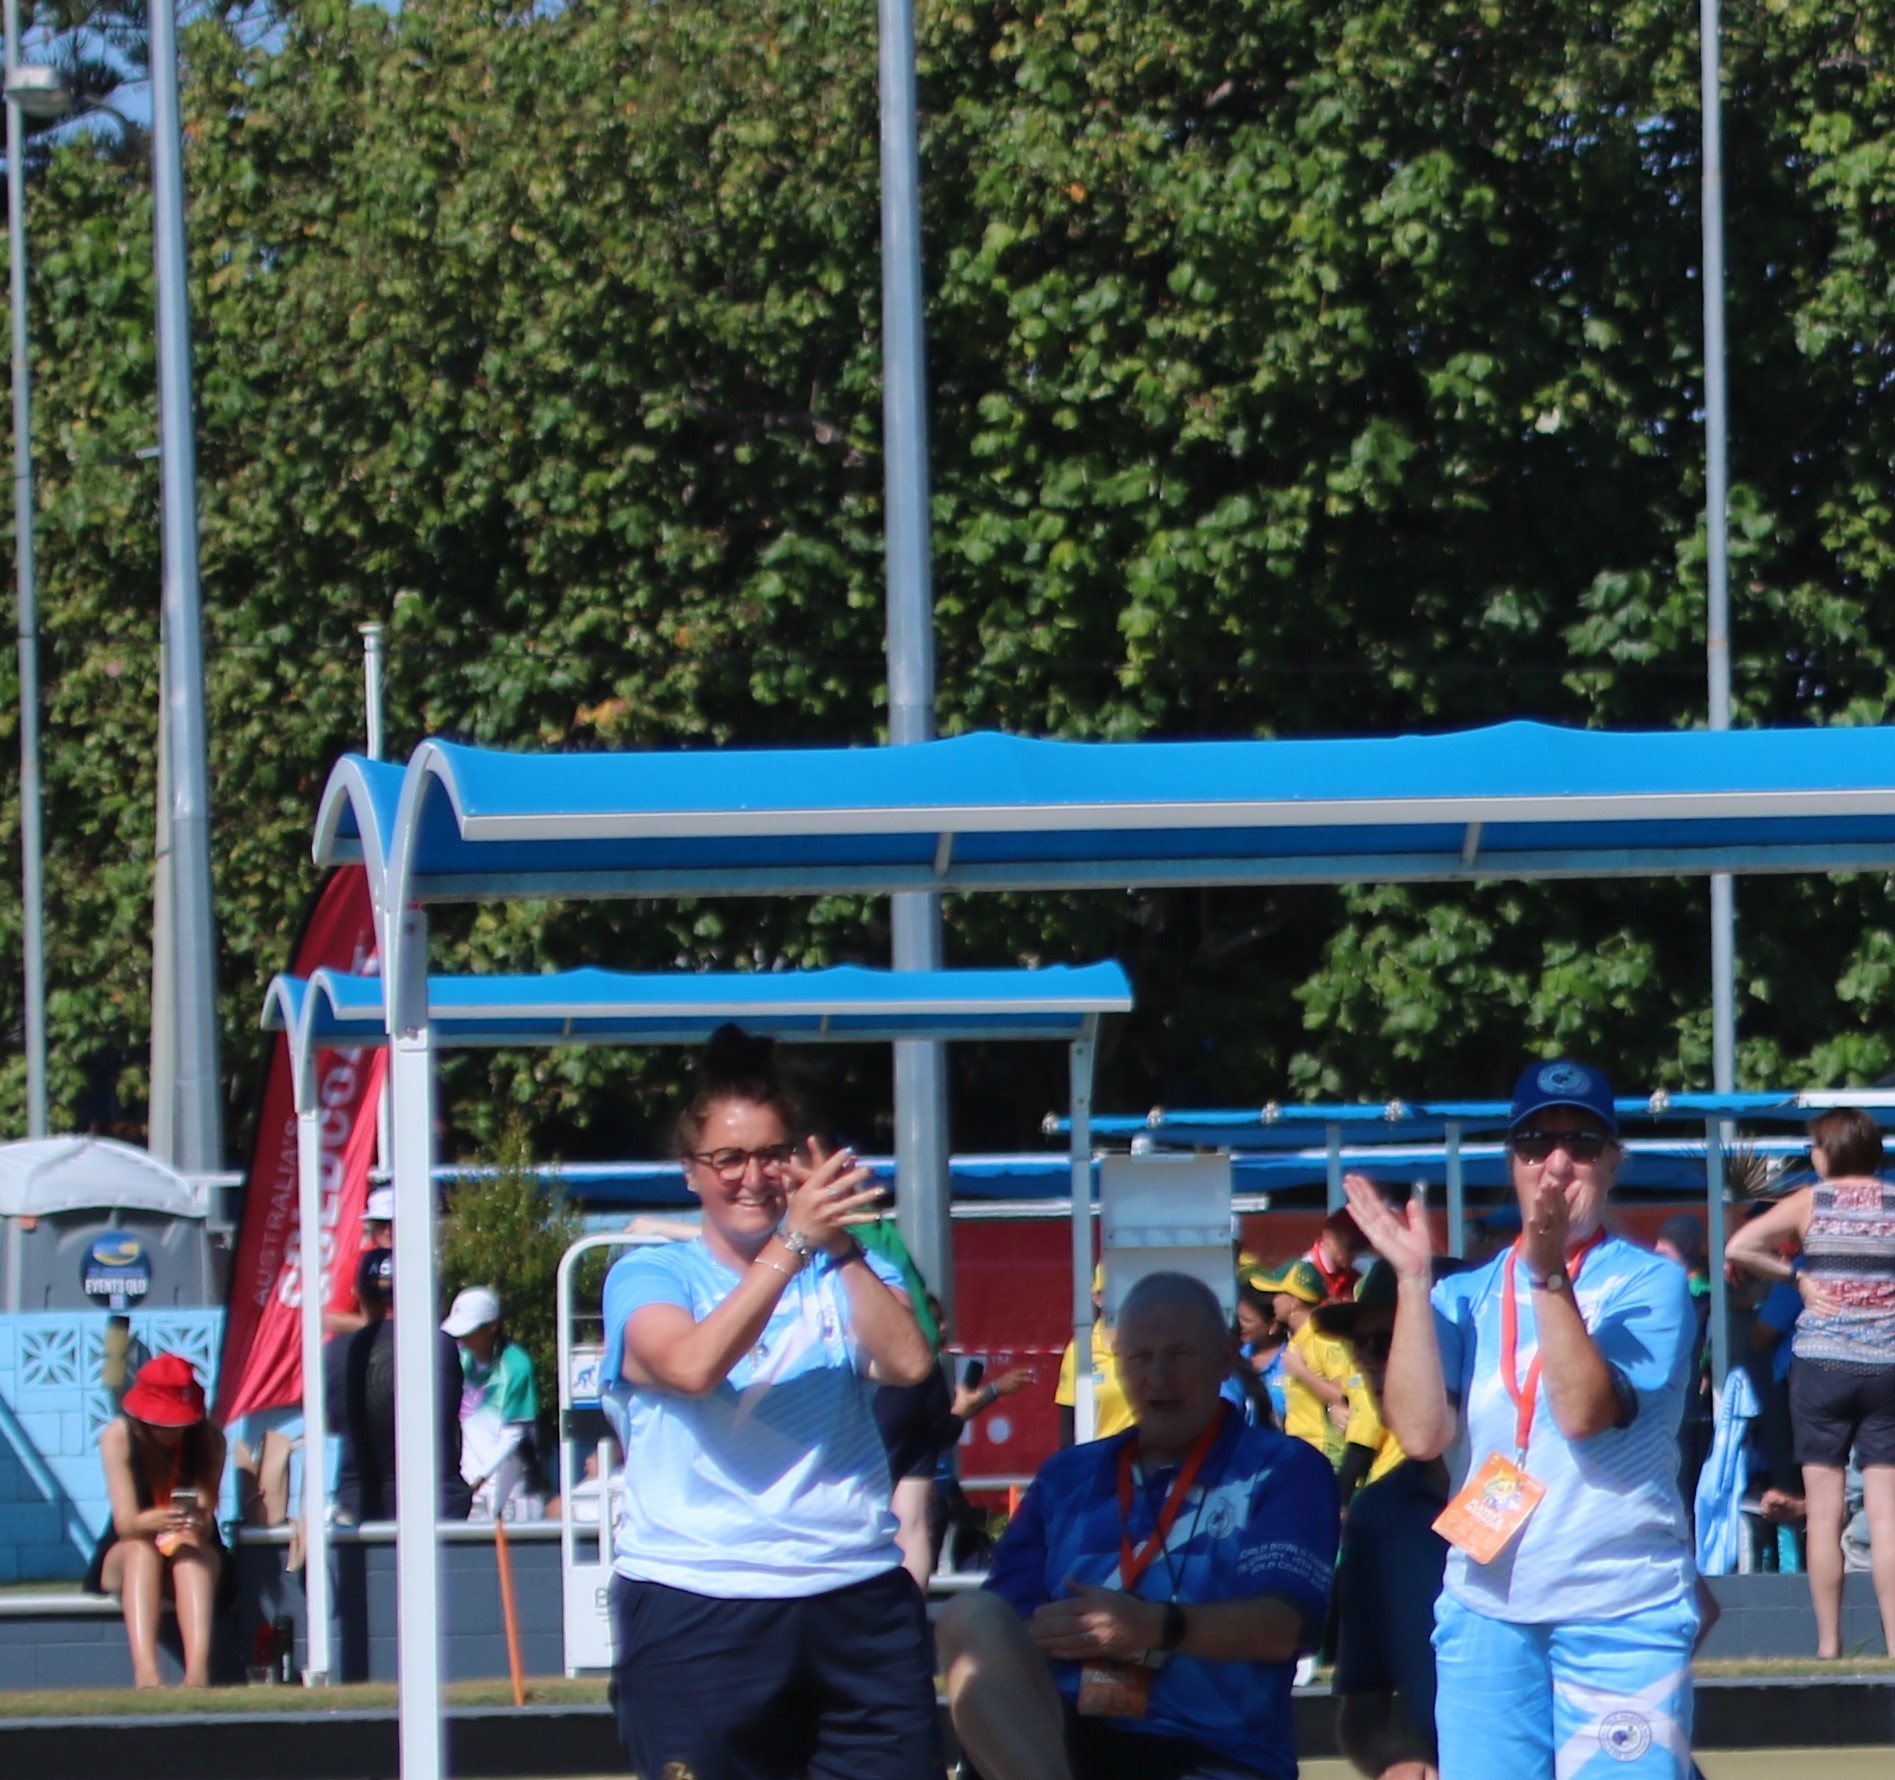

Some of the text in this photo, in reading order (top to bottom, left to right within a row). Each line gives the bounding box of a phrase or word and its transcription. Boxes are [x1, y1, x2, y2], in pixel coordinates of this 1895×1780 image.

[253, 1115, 298, 1307] AUSTRALIA'S
[84, 1278, 147, 1297] EVENTS QLD
